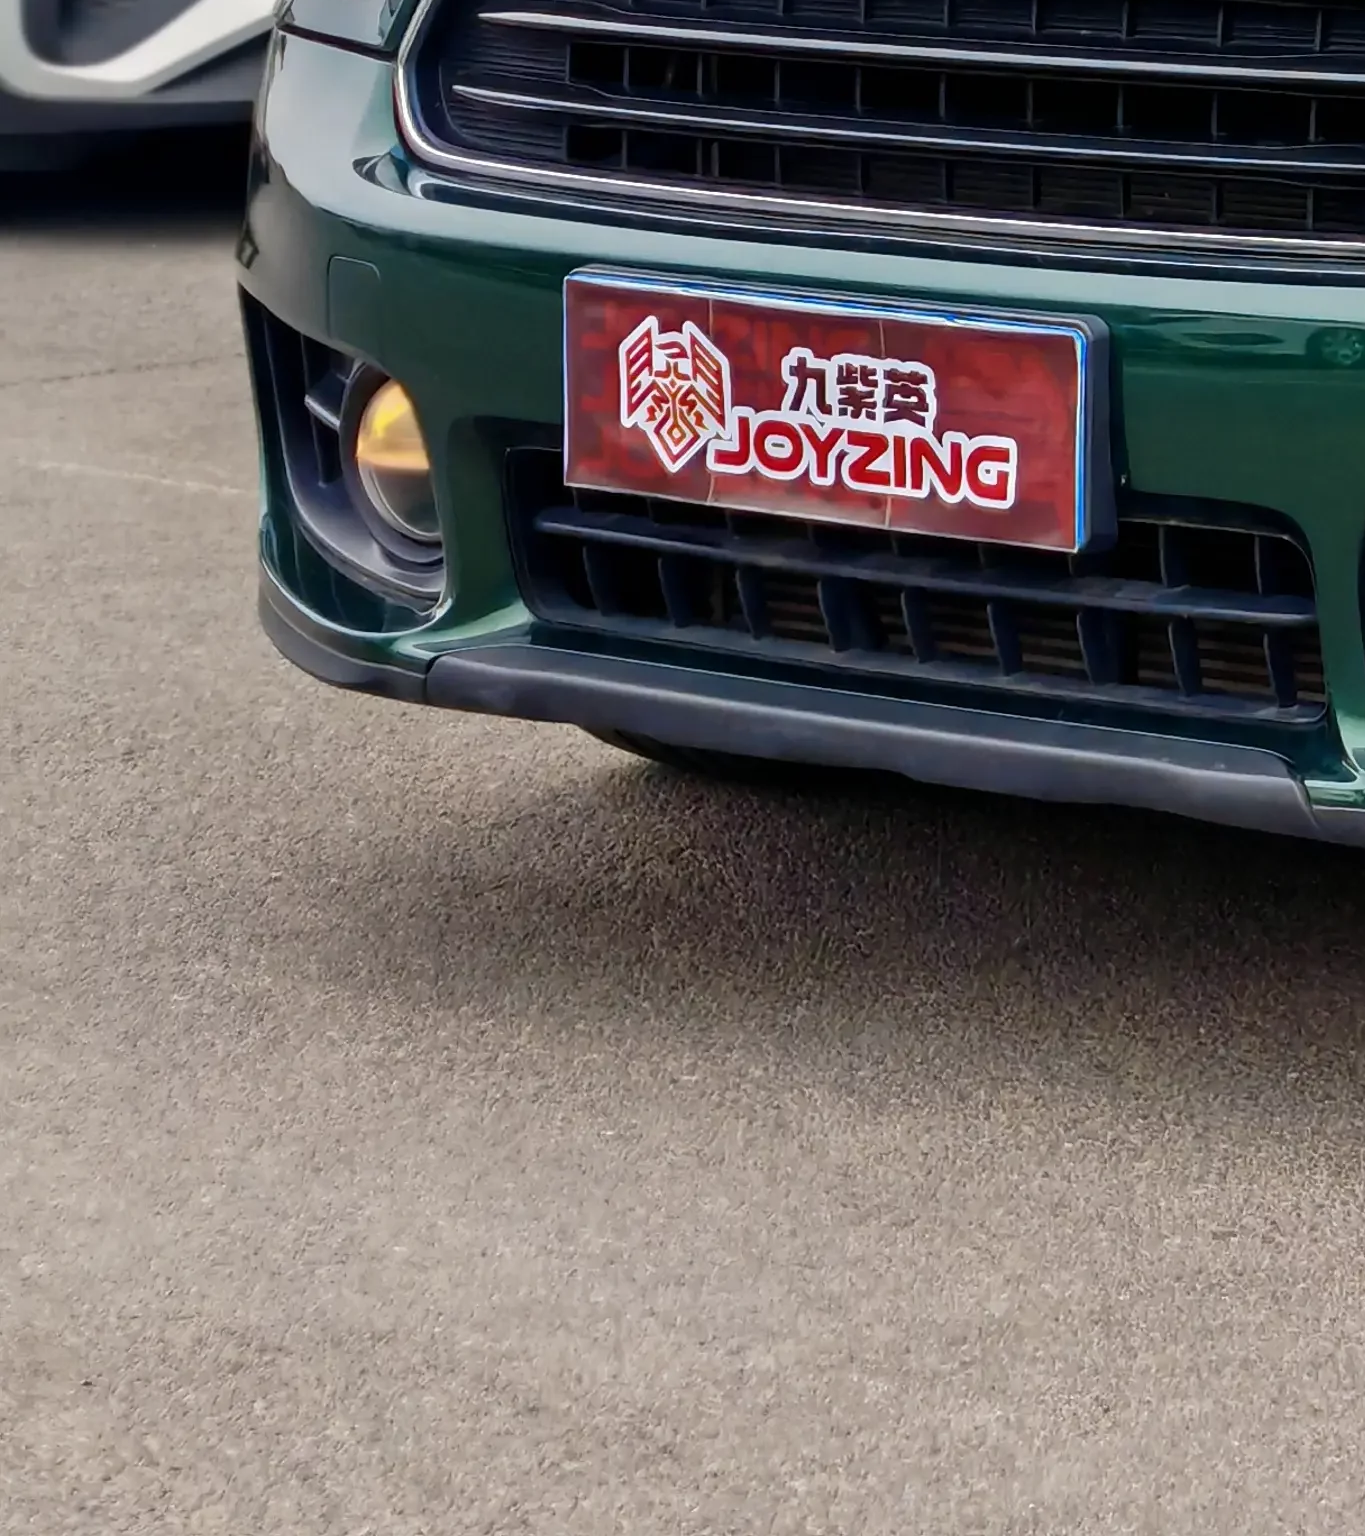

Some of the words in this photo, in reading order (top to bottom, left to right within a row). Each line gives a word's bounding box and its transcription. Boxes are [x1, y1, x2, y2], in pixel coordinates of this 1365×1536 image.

[788, 356, 930, 426] 九紫英
[711, 415, 1011, 502] JOYZING
